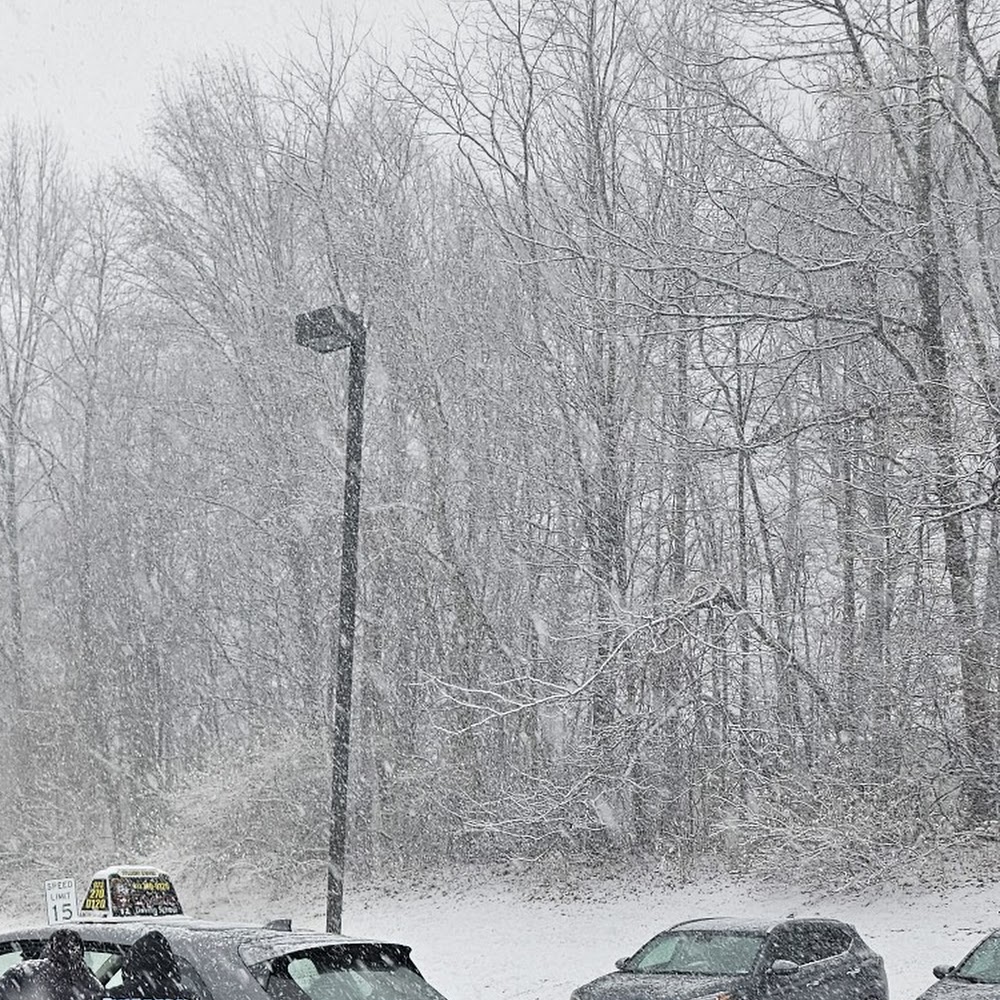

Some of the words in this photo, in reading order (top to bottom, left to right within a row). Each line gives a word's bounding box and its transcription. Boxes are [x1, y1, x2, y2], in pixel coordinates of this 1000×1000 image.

[47, 880, 73, 890] SPEED
[50, 893, 71, 901] LIMIT
[90, 889, 105, 899] 270
[85, 899, 106, 909] 0120
[52, 904, 73, 921] 15
